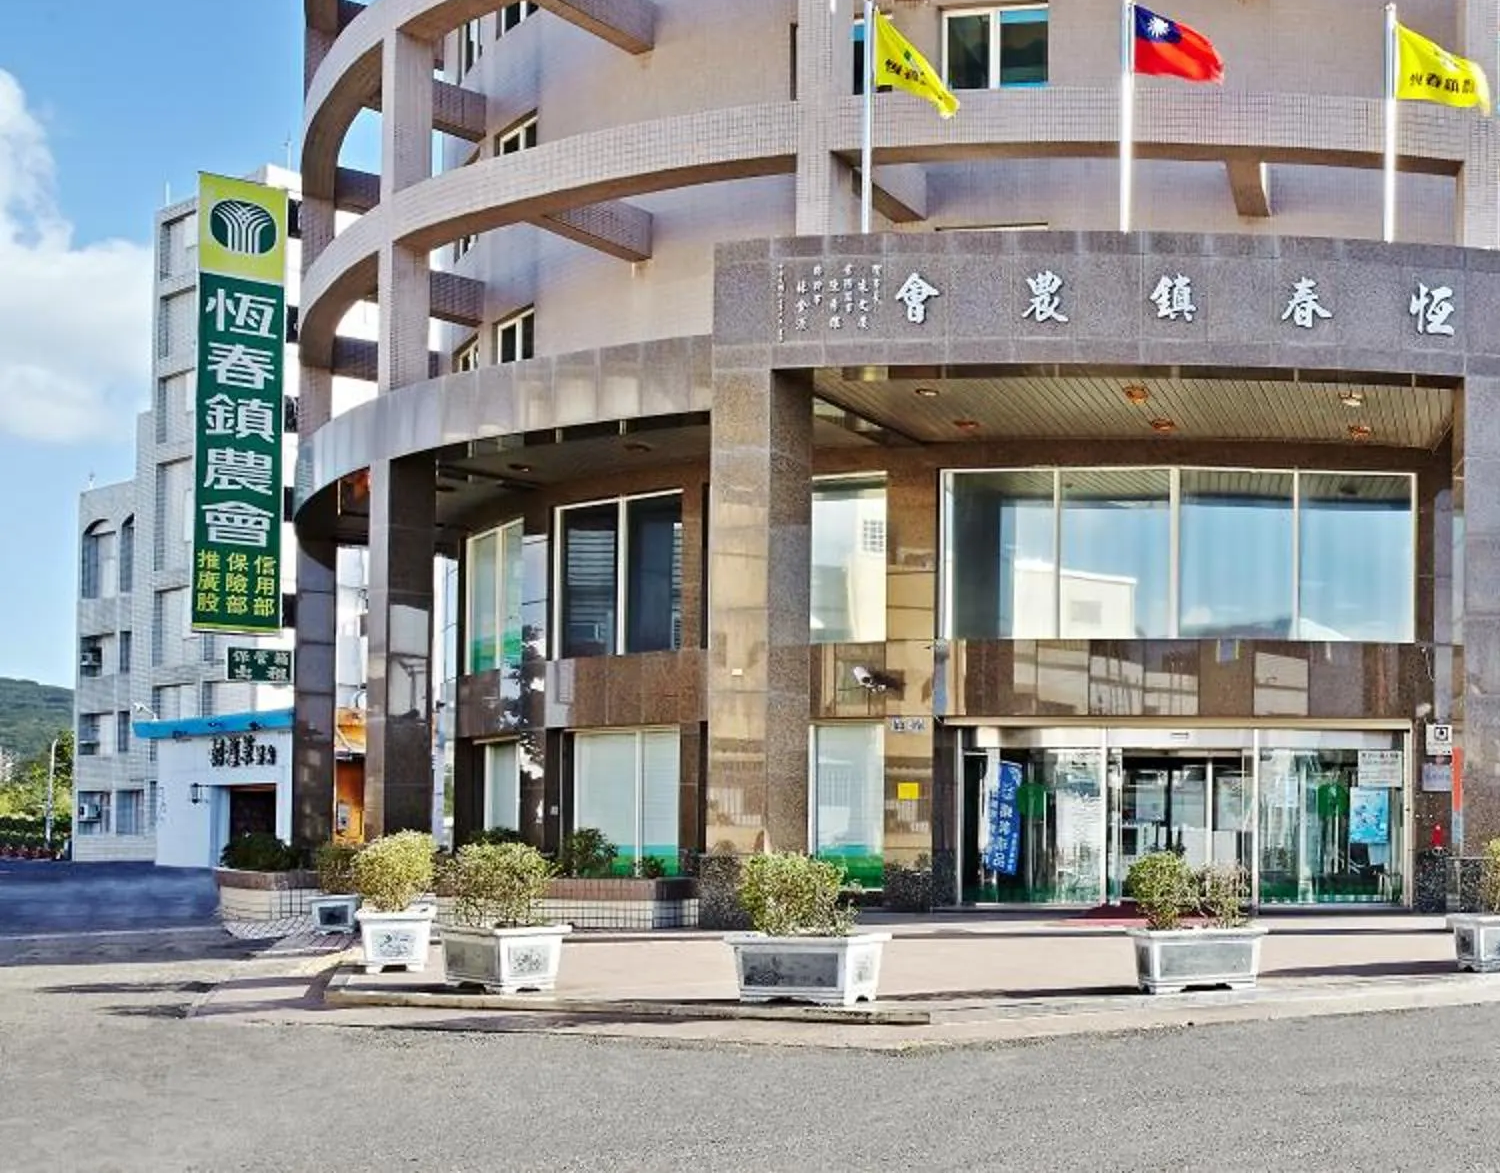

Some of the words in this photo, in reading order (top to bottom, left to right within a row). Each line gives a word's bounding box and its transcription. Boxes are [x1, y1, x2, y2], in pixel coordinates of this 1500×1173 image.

[202, 288, 278, 548] 恆春鎮農會
[197, 549, 221, 612] 推廣股
[226, 552, 249, 615] 保險部
[253, 555, 277, 617] 信用部
